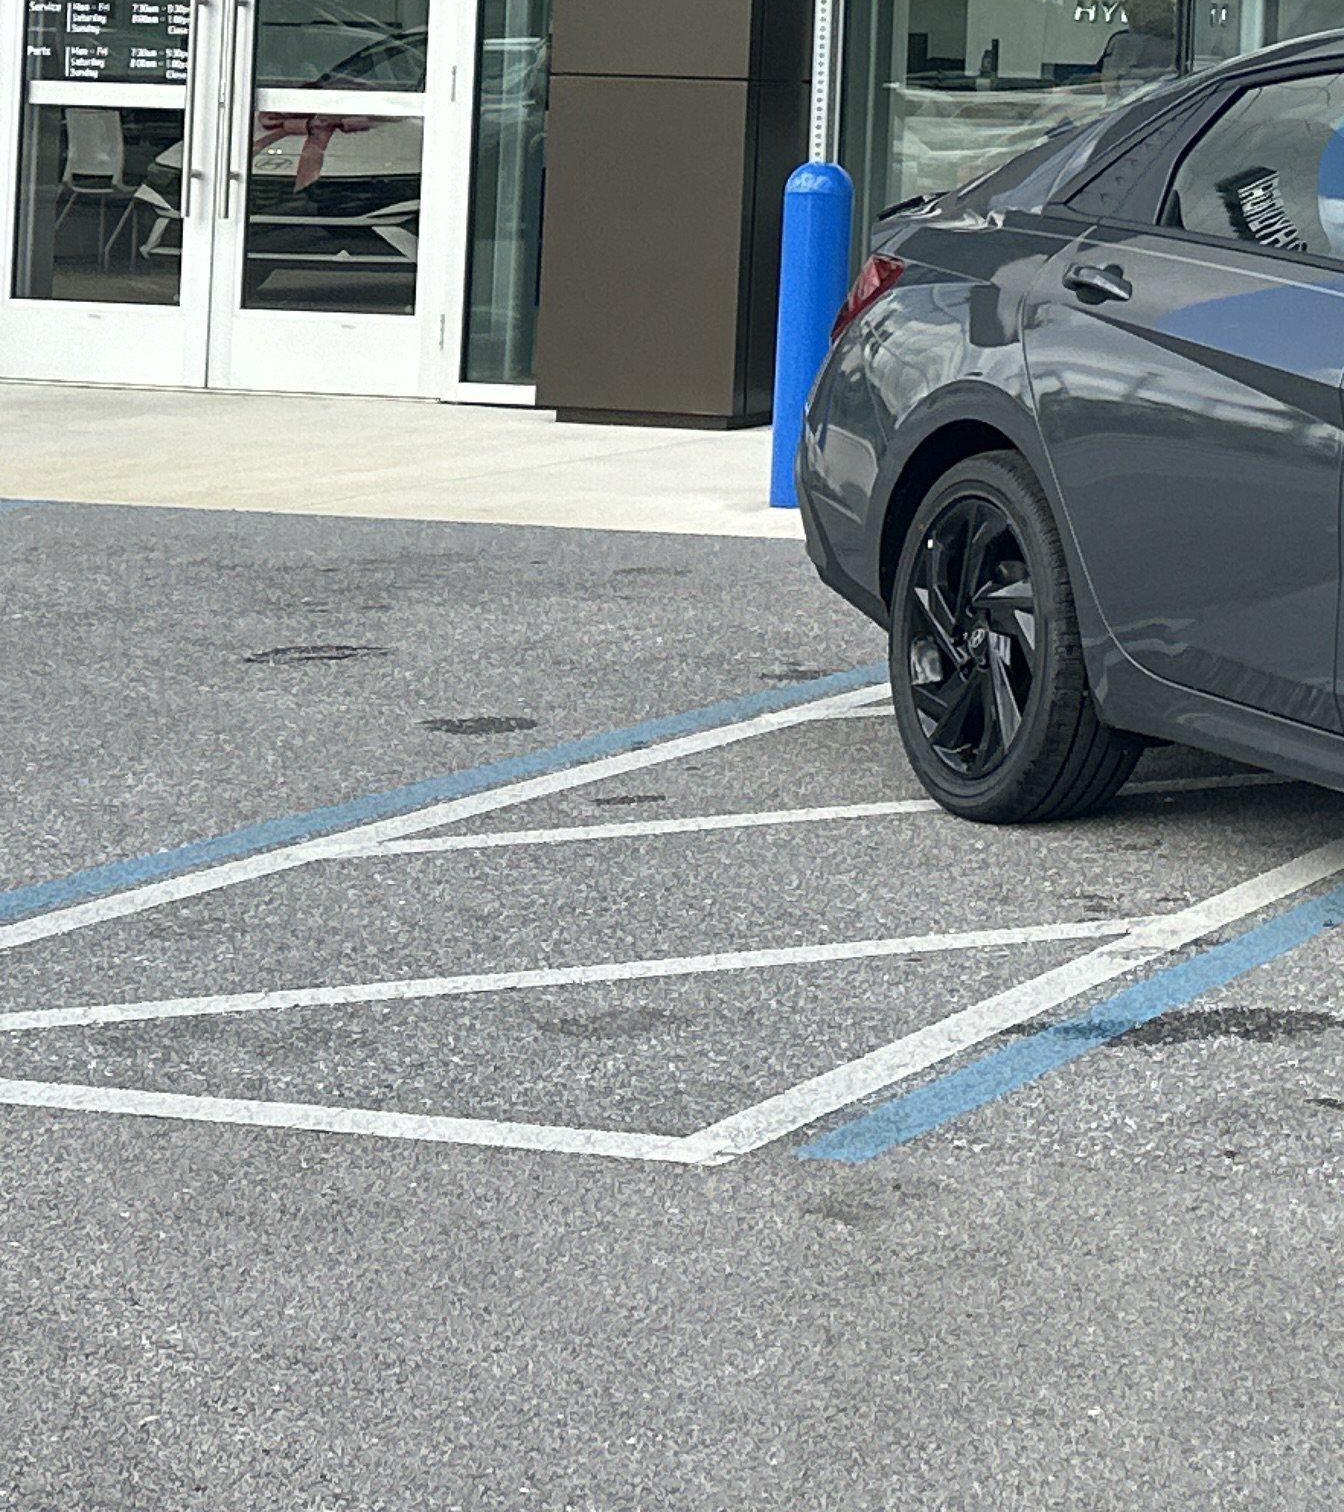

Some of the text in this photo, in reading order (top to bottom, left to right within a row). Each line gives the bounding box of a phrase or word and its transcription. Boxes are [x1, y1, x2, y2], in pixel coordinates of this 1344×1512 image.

[29, 1, 62, 12] Service
[72, 13, 107, 25] Saturday
[71, 24, 100, 35] Sunday
[26, 45, 51, 56] Parts
[70, 57, 106, 69] Saturday
[69, 68, 99, 79] Sunday
